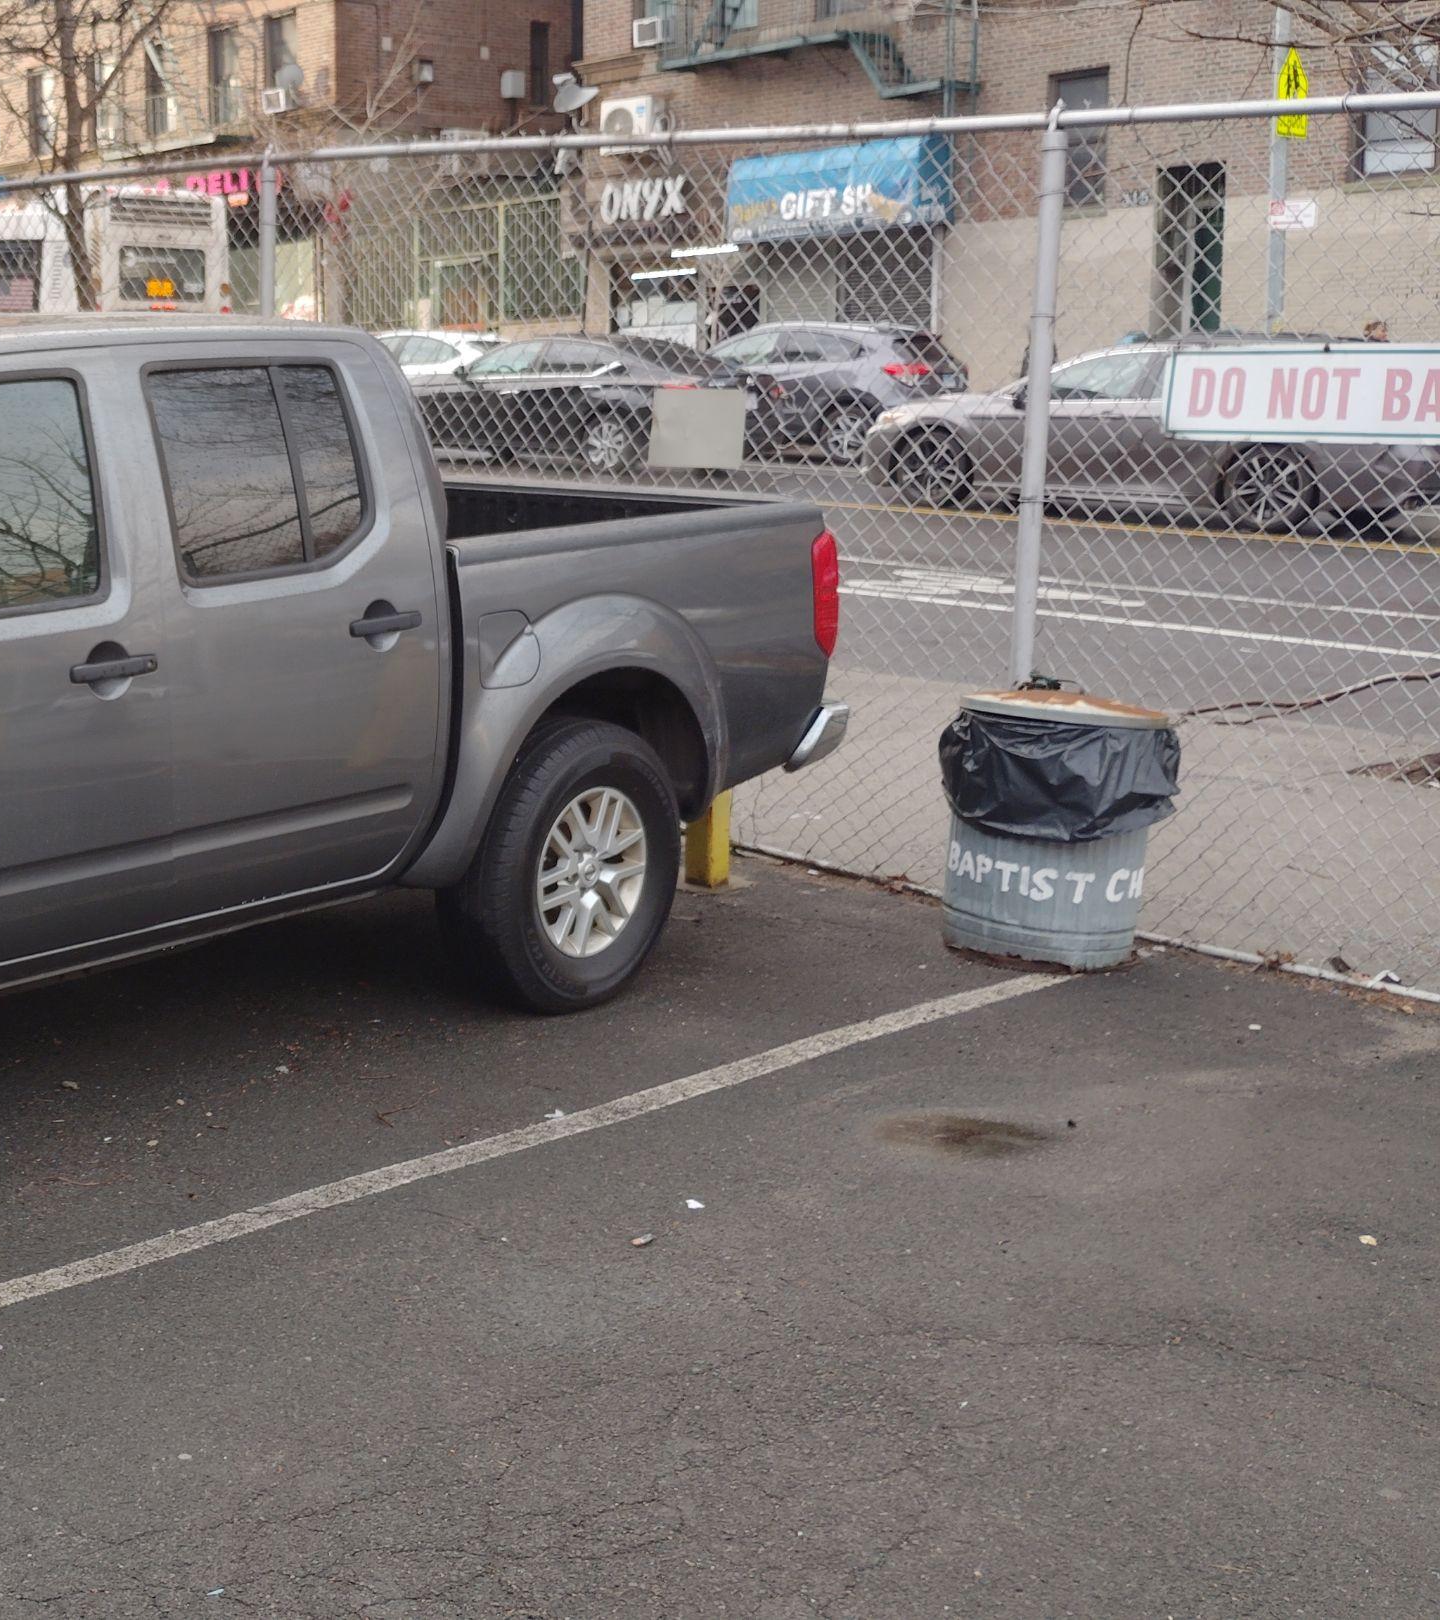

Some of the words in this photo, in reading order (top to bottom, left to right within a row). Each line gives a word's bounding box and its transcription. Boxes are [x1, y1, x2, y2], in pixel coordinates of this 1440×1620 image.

[185, 167, 249, 195] DELI
[600, 174, 686, 225] ONYX
[780, 187, 838, 220] GIFT
[1187, 367, 1247, 419] DO
[1266, 367, 1361, 421] NOT
